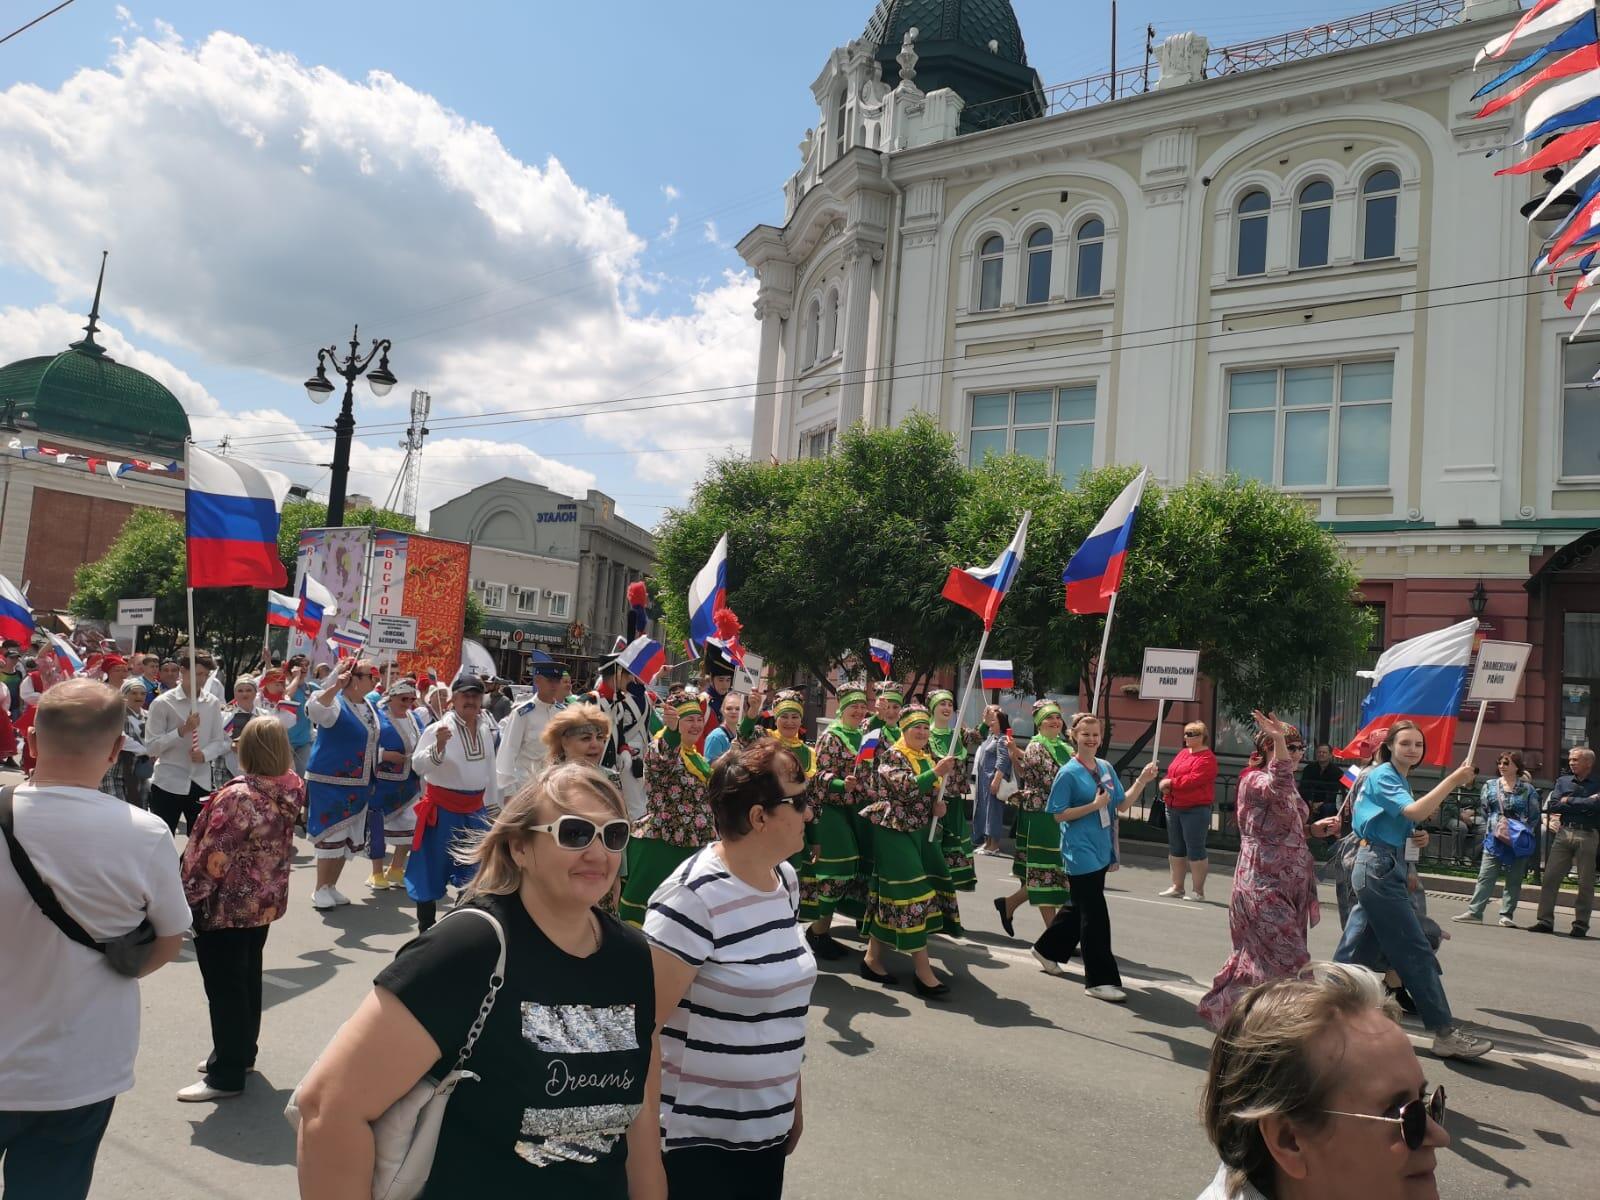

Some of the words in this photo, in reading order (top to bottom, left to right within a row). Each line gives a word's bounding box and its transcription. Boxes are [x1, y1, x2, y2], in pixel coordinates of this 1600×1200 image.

[536, 511, 577, 522] ЭТАЛОН
[1146, 665, 1195, 675] ИСИЛЬКУЛЬСКИЙ
[1482, 660, 1517, 672] ЗНАМЕНСКИЙ
[1159, 676, 1177, 685] РАЙОН
[1486, 673, 1504, 684] РАЙОН
[545, 1059, 635, 1096] Dreams
